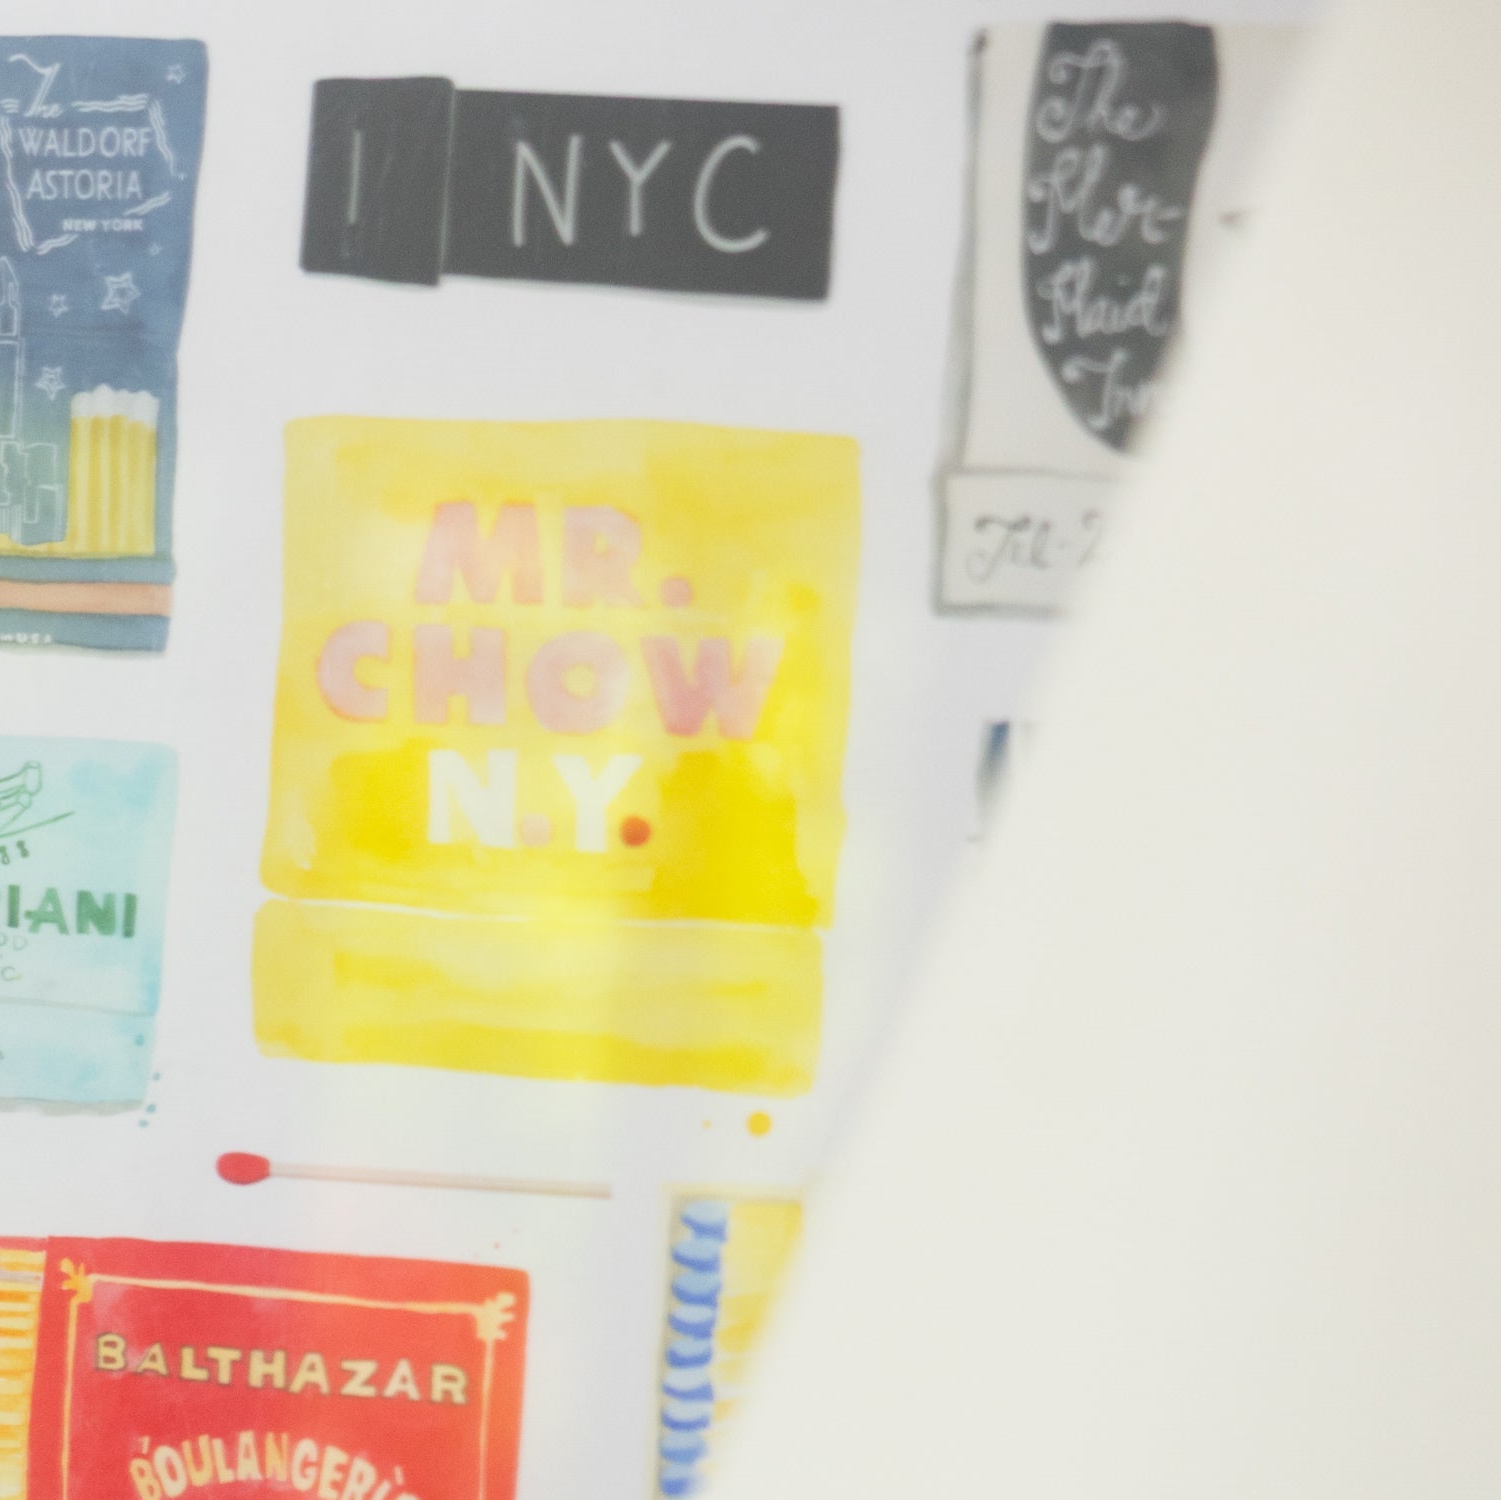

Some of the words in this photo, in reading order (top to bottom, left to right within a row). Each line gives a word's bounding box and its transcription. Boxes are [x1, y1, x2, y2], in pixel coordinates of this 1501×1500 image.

[18, 126, 150, 158] WALDORF
[26, 169, 143, 200] ASTORIA
[62, 218, 97, 232] NEW
[100, 218, 144, 232] YORK
[513, 133, 769, 254] NYC
[413, 499, 694, 609] MR.
[315, 618, 787, 742] CHOW
[427, 747, 653, 854] N.Y.
[94, 1331, 470, 1405] BALTHAZAR
